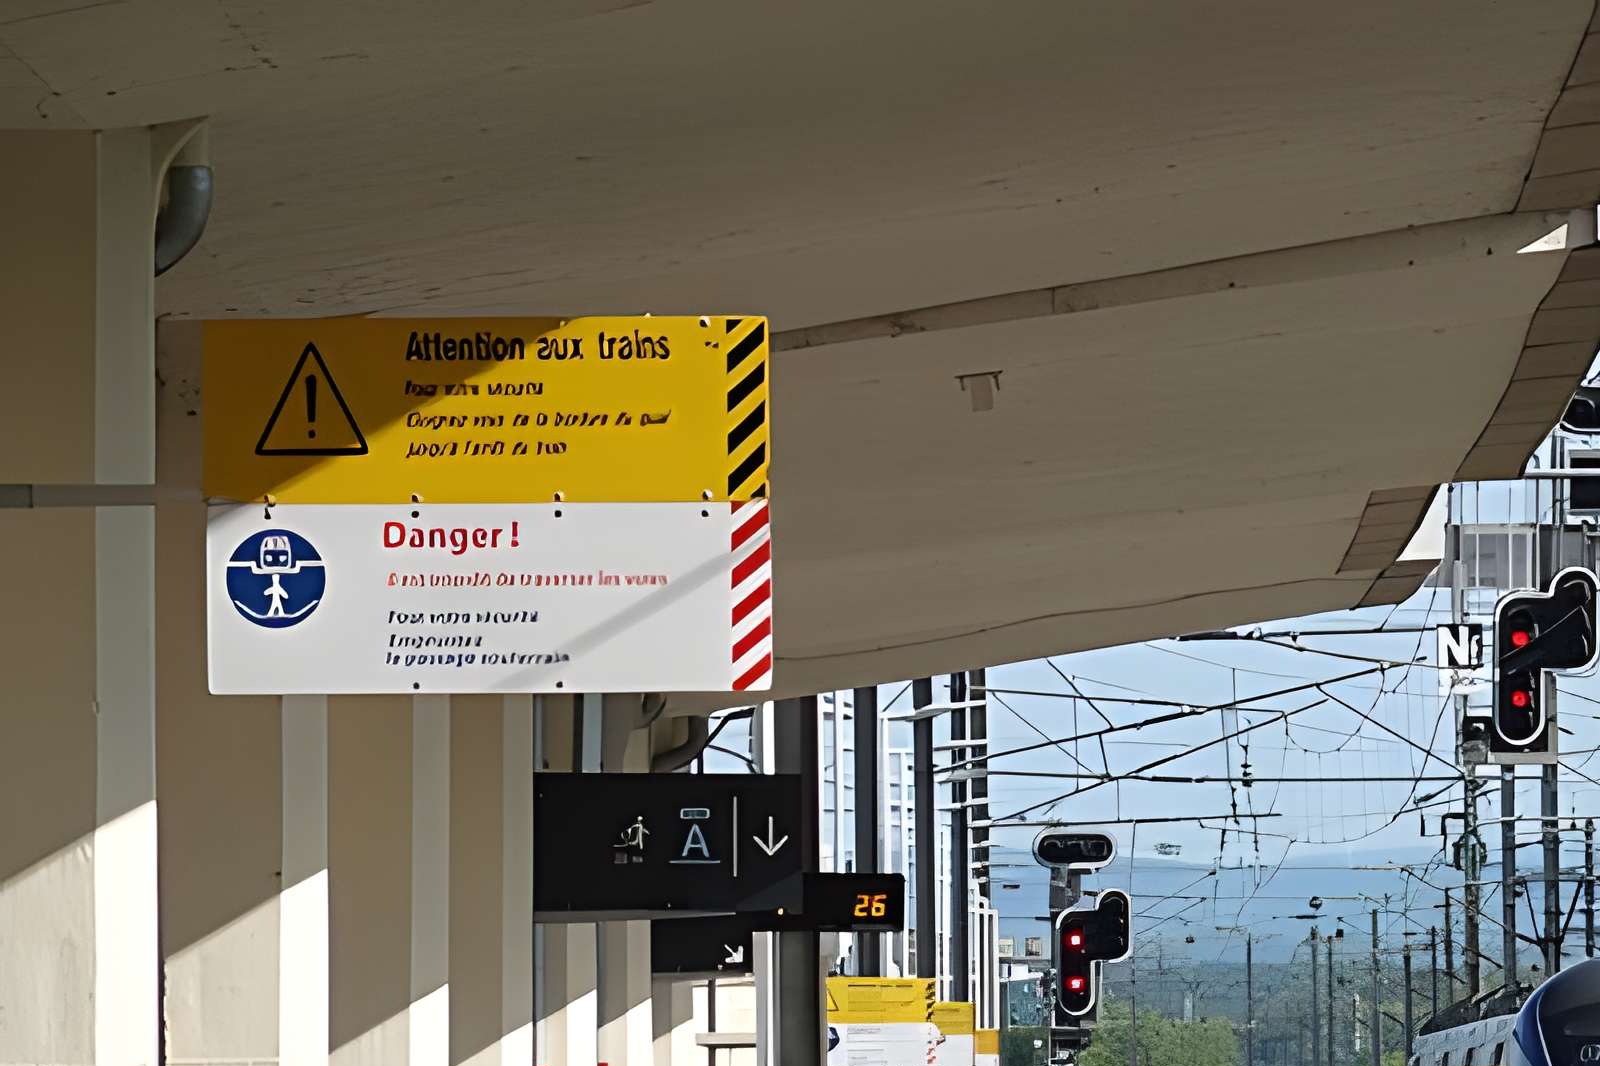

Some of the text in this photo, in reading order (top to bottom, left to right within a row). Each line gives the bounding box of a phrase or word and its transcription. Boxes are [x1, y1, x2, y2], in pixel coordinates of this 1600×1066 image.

[405, 329, 671, 361] Attention aux trains
[681, 823, 710, 858] A
[854, 894, 887, 917] 26
